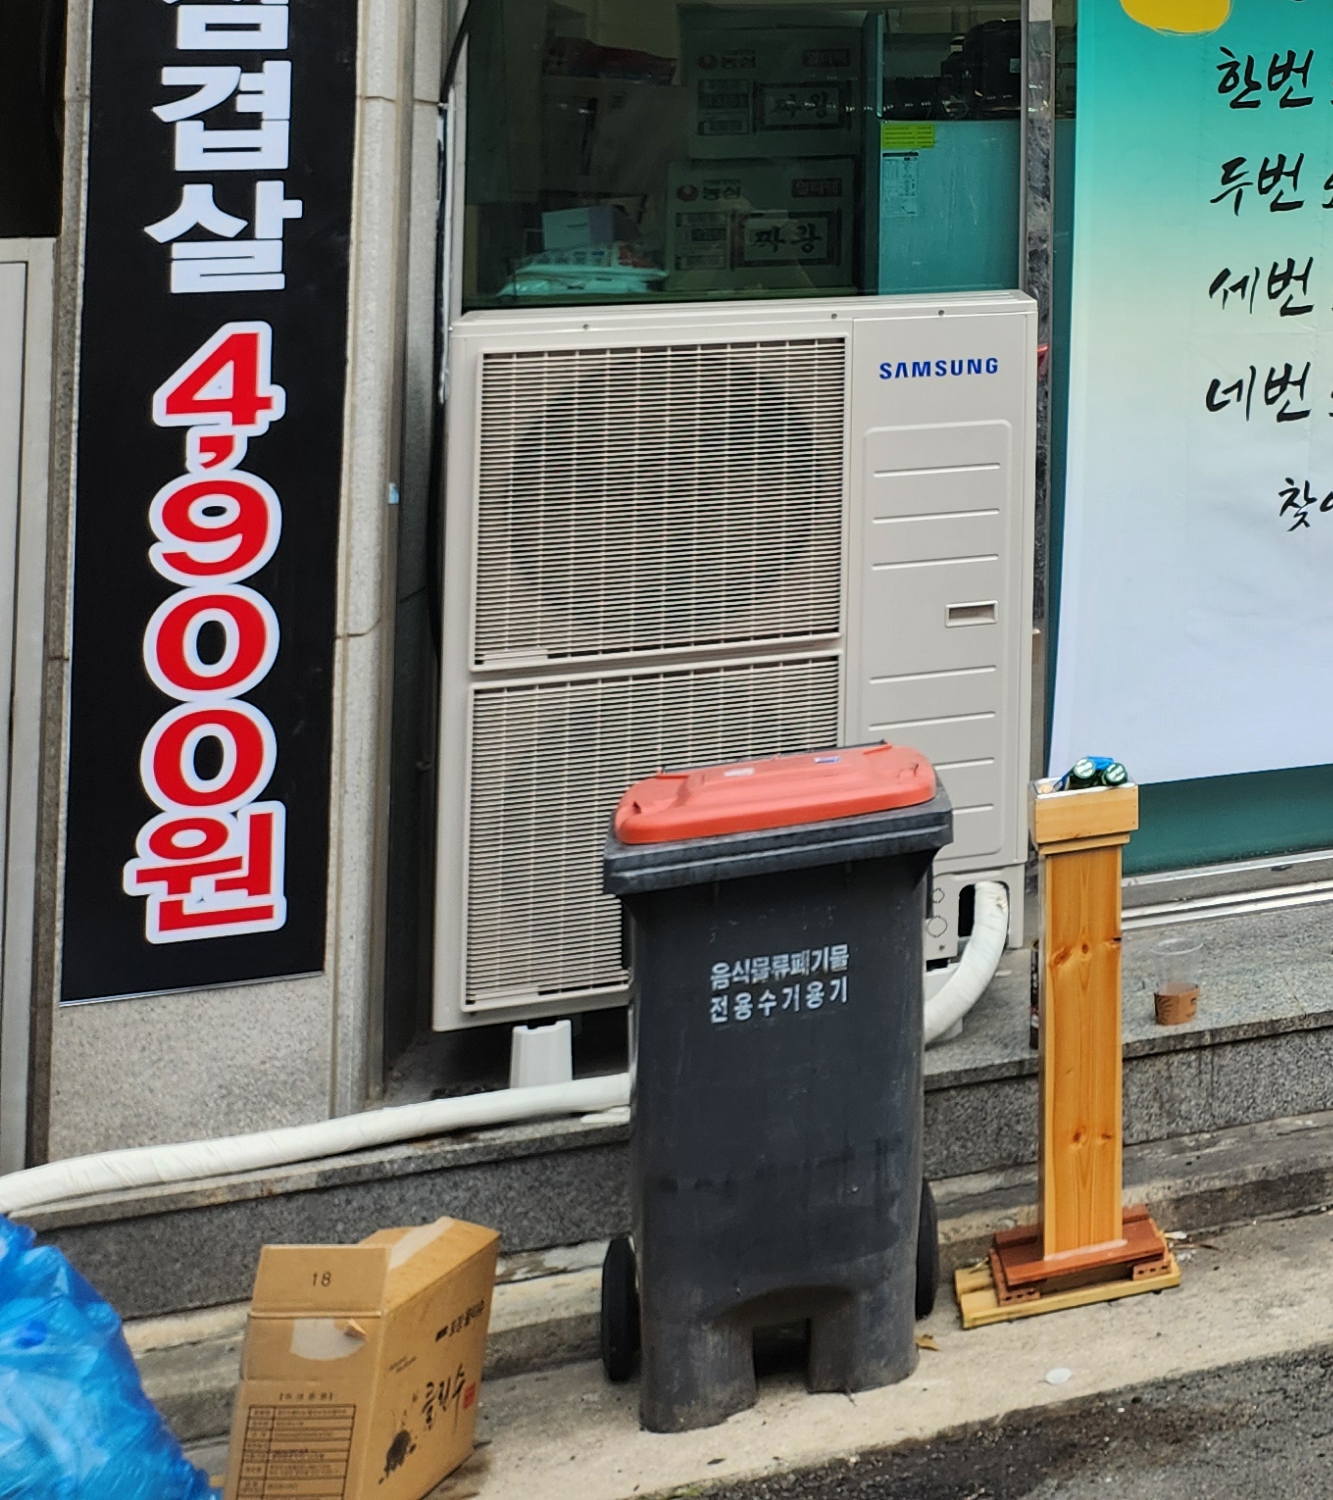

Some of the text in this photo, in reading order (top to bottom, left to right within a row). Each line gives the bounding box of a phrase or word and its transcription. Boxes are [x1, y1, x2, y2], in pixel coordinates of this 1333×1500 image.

[1217, 47, 1314, 109] 한번
[1210, 153, 1304, 215] 두번
[1209, 257, 1313, 316] 세번
[878, 356, 1000, 380] SAMSUNG
[1206, 362, 1310, 422] 네번
[123, 321, 287, 944] 4,900원
[710, 944, 849, 991] 음식물류폐기물
[310, 1270, 333, 1288] 18
